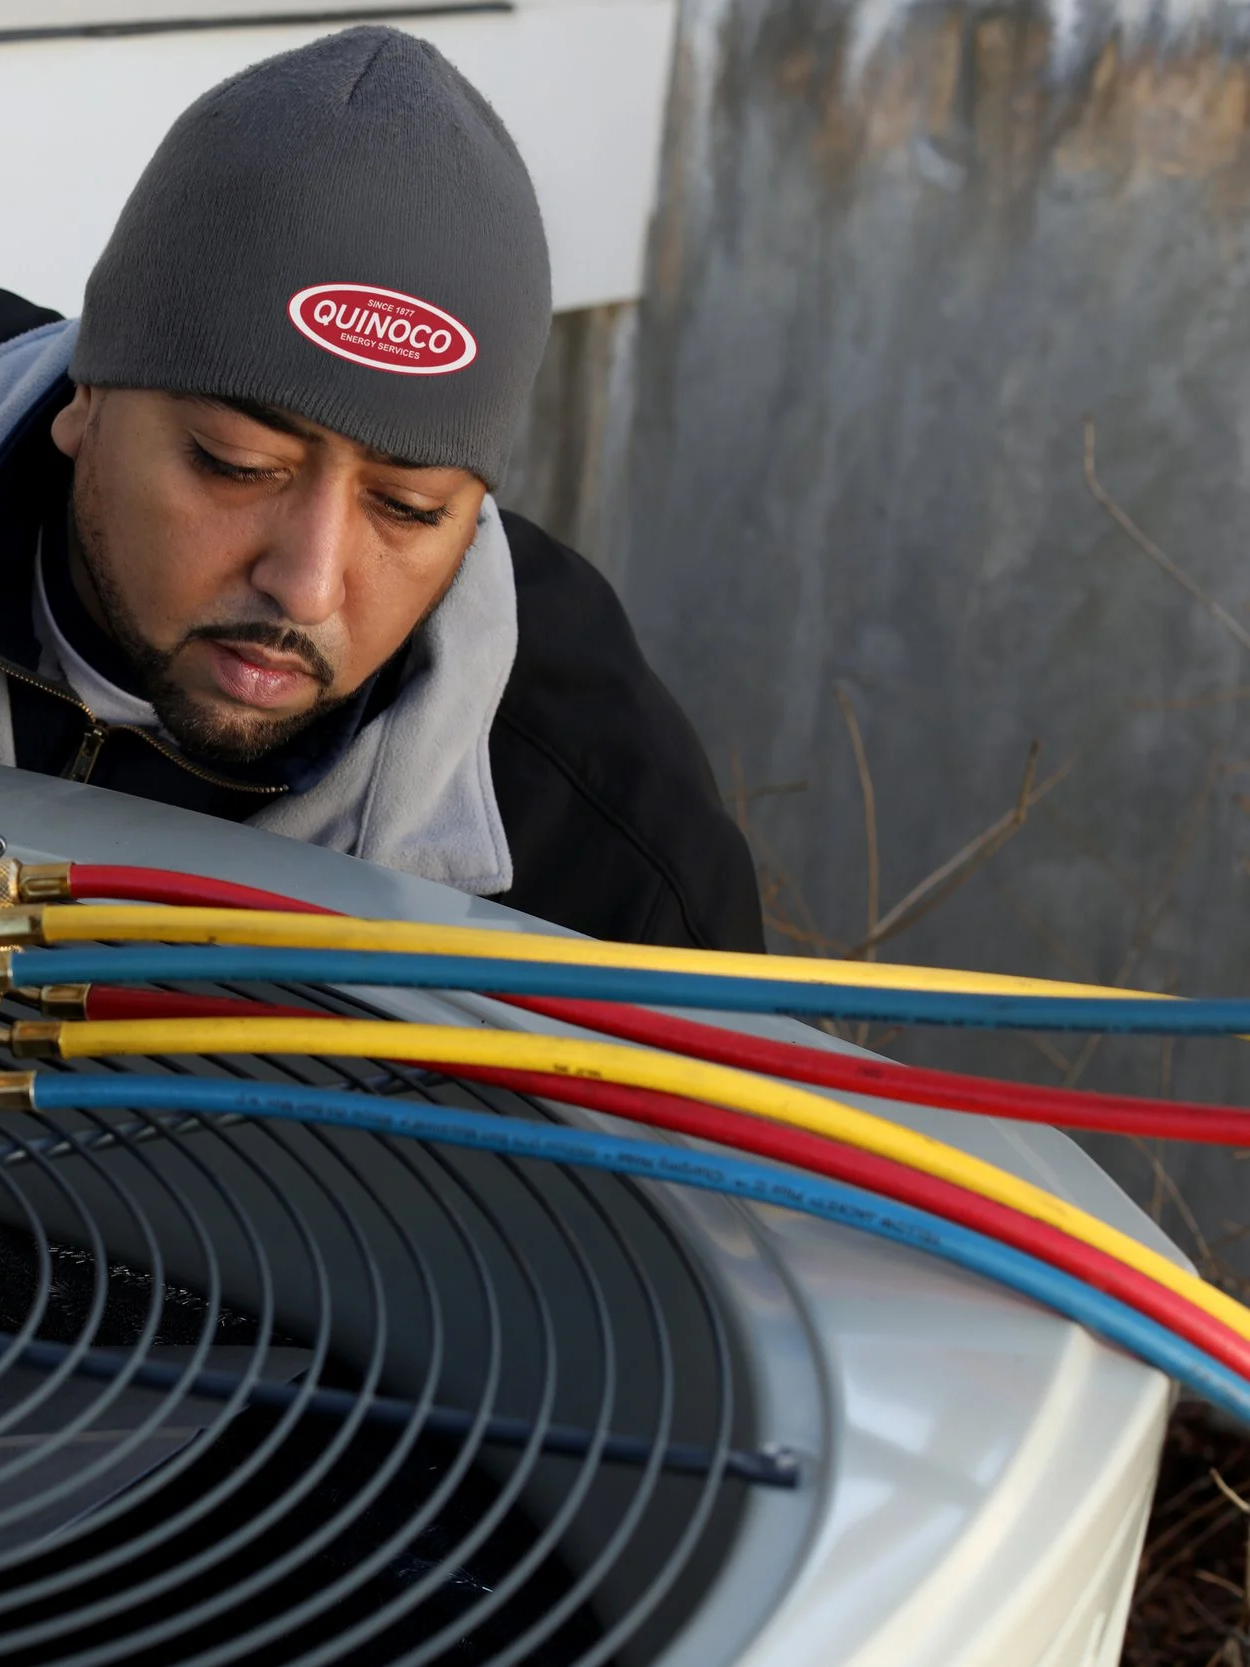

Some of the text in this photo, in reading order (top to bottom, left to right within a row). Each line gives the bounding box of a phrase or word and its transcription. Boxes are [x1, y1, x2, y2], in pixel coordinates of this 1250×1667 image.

[367, 299, 416, 318] SINCE 1877
[313, 299, 453, 354] QUINOCO
[340, 332, 421, 360] ENERGY SERVICES
